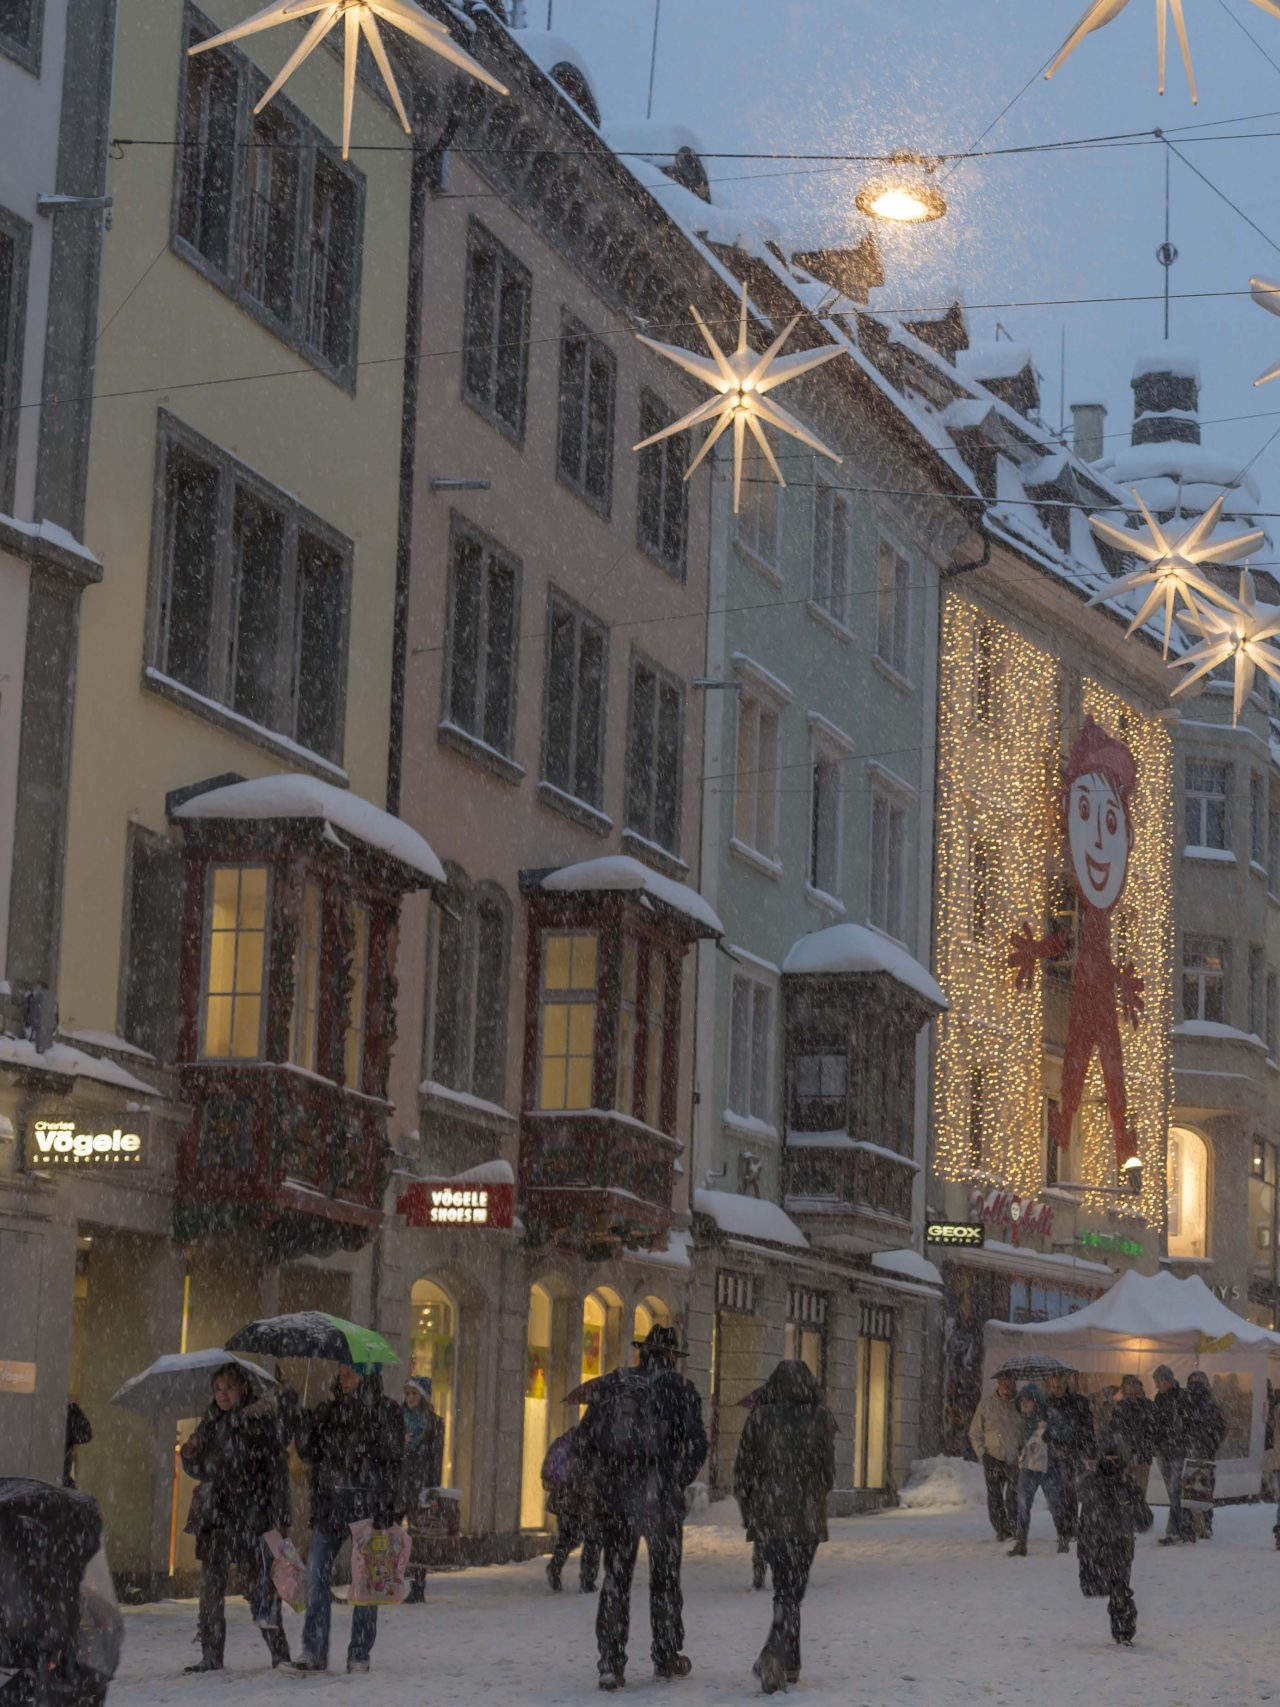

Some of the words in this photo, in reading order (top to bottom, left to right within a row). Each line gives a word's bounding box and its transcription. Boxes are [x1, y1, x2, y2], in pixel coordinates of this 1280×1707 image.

[34, 1129, 141, 1157] Vögele
[431, 1187, 489, 1207] VÖGELE
[430, 1207, 472, 1223] SHOES
[927, 1224, 982, 1239] GEOX
